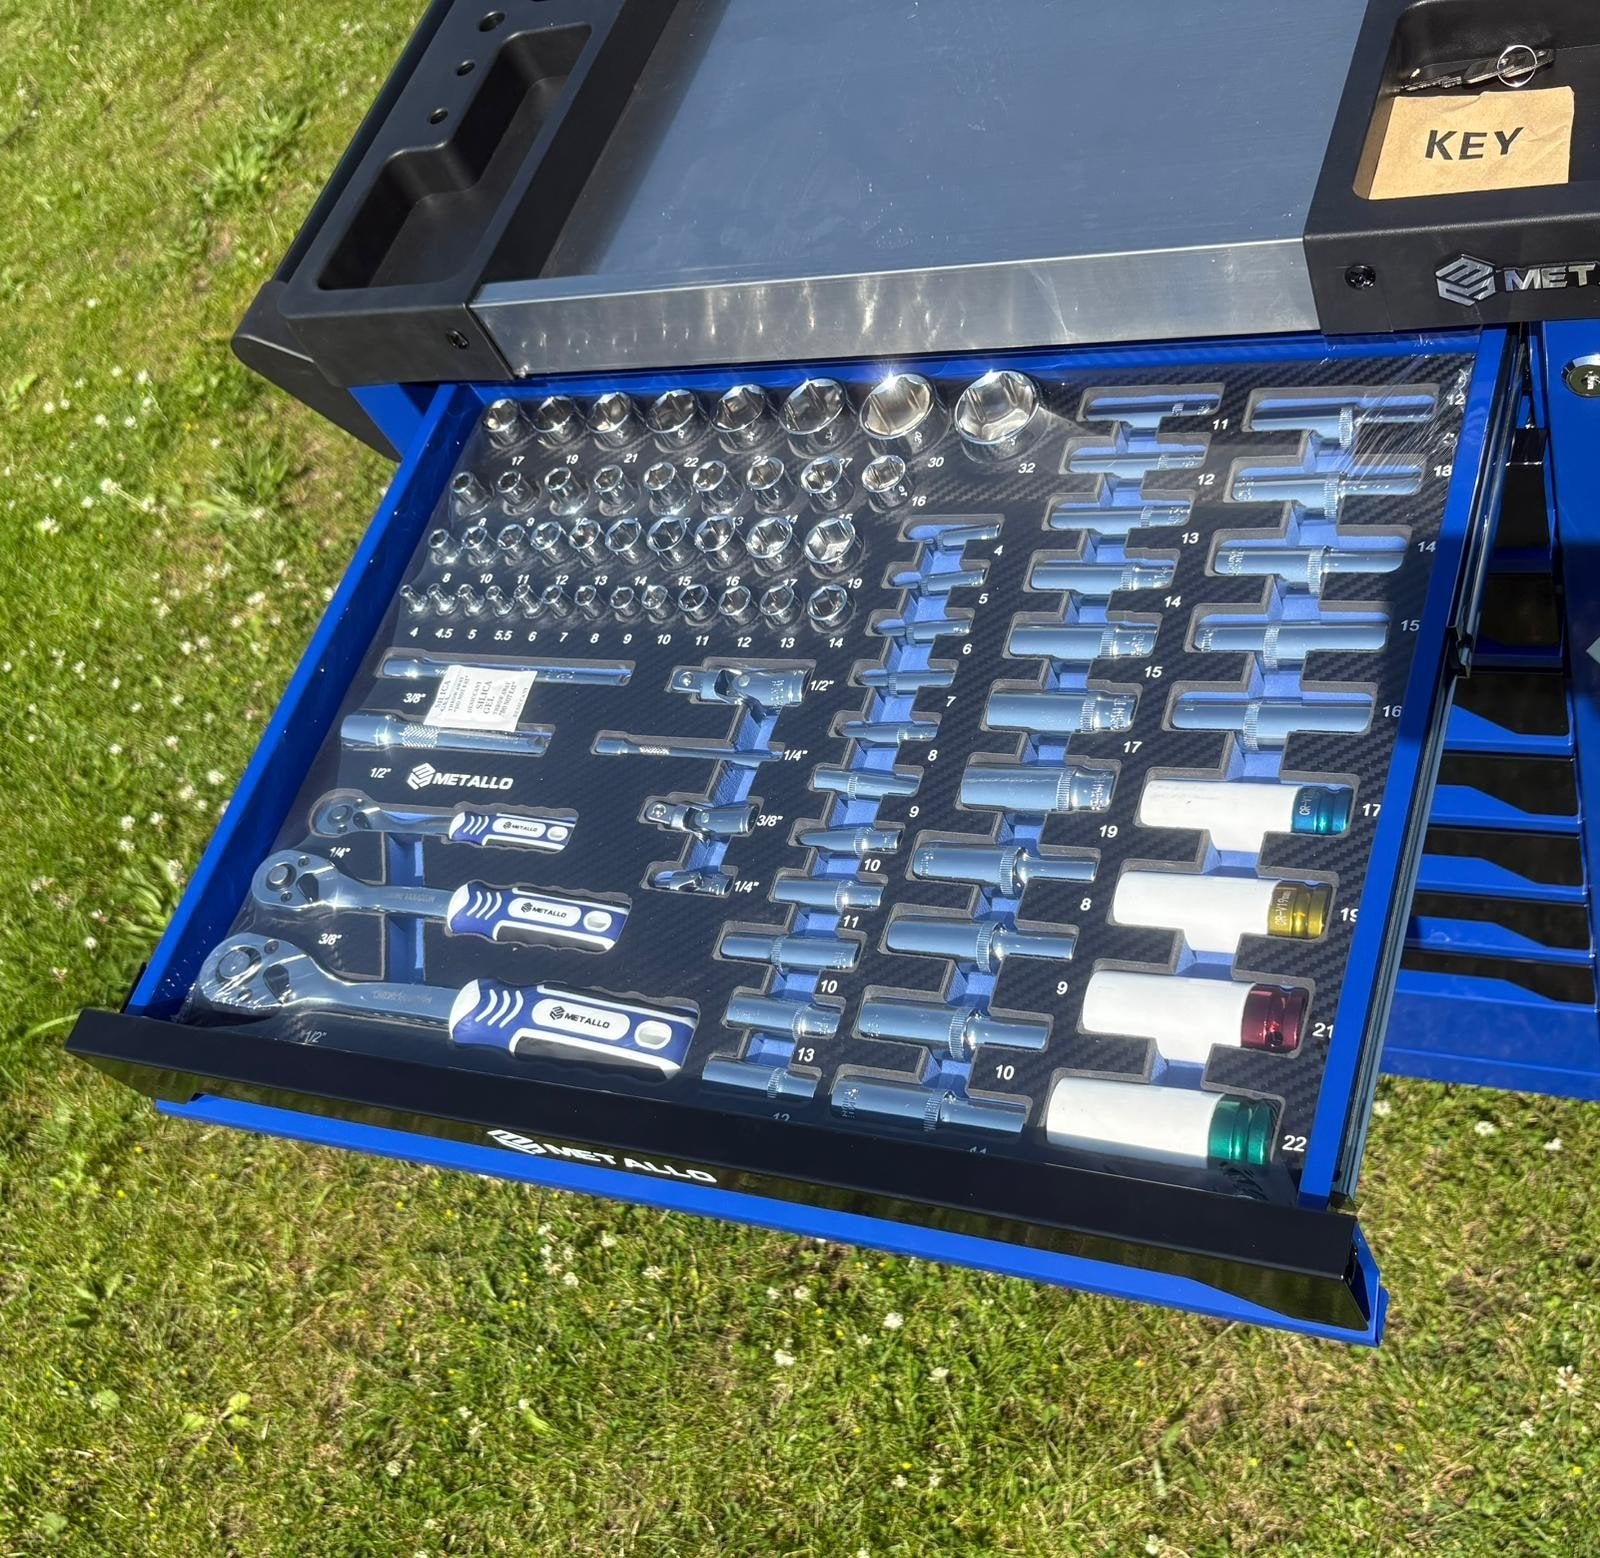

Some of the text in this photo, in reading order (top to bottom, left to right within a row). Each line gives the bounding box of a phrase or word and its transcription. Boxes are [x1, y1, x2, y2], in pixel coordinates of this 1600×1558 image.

[1424, 127, 1524, 161] KEY
[1504, 262, 1600, 292] MET
[1446, 394, 1465, 405] 12
[1213, 419, 1228, 430] 11
[512, 456, 524, 465] 17
[567, 455, 578, 464] 19
[624, 453, 637, 463] 21
[684, 457, 698, 467] 22
[928, 457, 944, 467] 30
[1018, 463, 1035, 473] 32
[1198, 474, 1215, 485] 12
[478, 518, 486, 526] 8
[527, 517, 534, 526] 9
[912, 496, 926, 506] 16
[1182, 533, 1199, 543] 13
[994, 546, 1003, 555] 4
[1418, 541, 1436, 552] 14
[443, 573, 451, 582] 8
[480, 574, 493, 583] 10
[518, 575, 529, 584] 11
[555, 575, 569, 585] 12
[595, 576, 608, 585] 13
[635, 576, 647, 585] 14
[678, 576, 691, 586] 15
[725, 576, 740, 586] 16
[848, 578, 862, 588] 19
[979, 594, 988, 604] 5
[1165, 596, 1181, 607] 14
[1401, 620, 1419, 631] 15
[410, 628, 843, 648] 4 4.5 5 5.5 6 7 8 9 10 11 12 13 14
[963, 644, 972, 654] 6
[1145, 666, 1162, 678] 15
[810, 680, 834, 691] 1/2"
[404, 693, 426, 703] 3/8"
[476, 680, 493, 710] SILICA
[947, 696, 956, 707] 7
[1383, 706, 1401, 717] 16
[1124, 741, 1142, 753] 17
[783, 750, 807, 761] 1/4"
[928, 750, 937, 761] 8
[371, 768, 391, 778] 1/2"
[433, 772, 513, 790] METALLO
[909, 806, 919, 817] 9
[1363, 804, 1381, 816] 17
[756, 815, 782, 826] 3/8"
[511, 824, 538, 832] METALLO
[1100, 825, 1118, 838] 19
[330, 847, 350, 858] 1/4"
[865, 859, 880, 871] 10
[735, 881, 759, 892] 1/4"
[1080, 898, 1091, 910] 8
[532, 907, 567, 918] METALLO
[844, 915, 859, 928] 11
[318, 933, 342, 945] 3/8"
[821, 980, 837, 993] 10
[1057, 981, 1068, 994] 9
[564, 1012, 610, 1029] METALLO
[1312, 1023, 1333, 1038] 21
[799, 1048, 814, 1062] 13
[996, 1065, 1014, 1080] 10
[1282, 1135, 1306, 1152] 22
